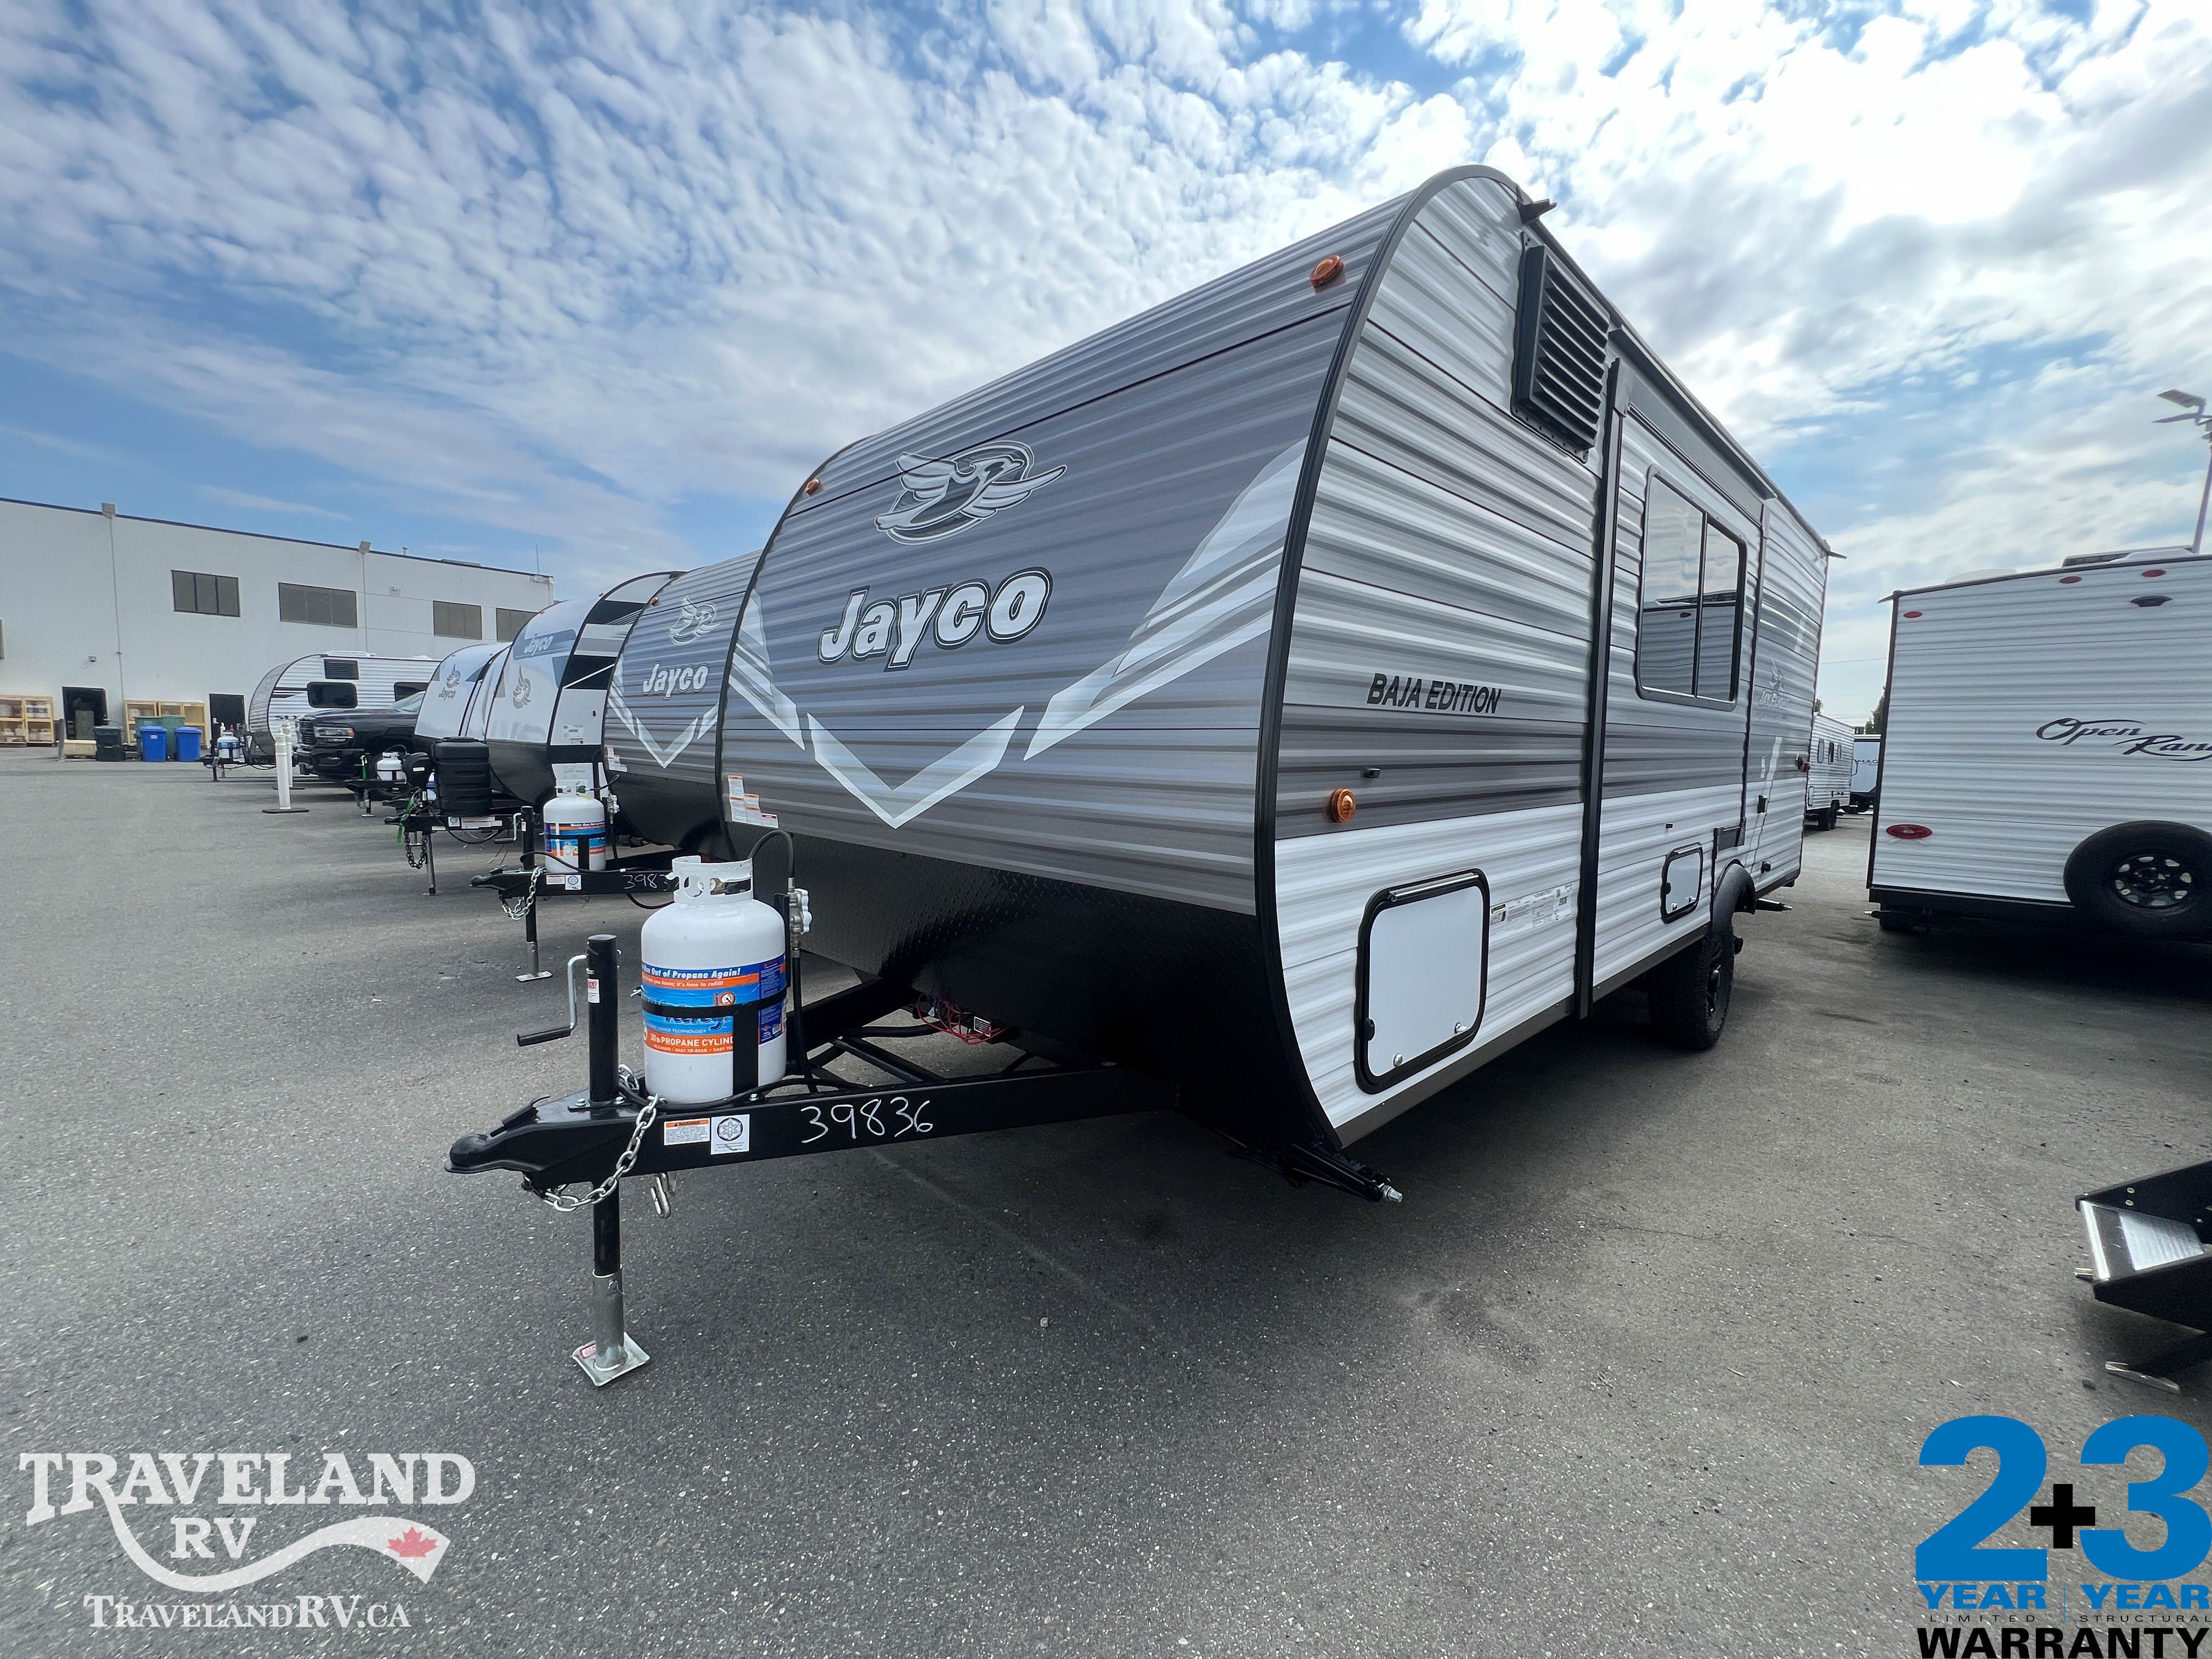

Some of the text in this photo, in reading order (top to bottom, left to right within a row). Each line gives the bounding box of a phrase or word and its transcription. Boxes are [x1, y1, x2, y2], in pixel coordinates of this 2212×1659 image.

[818, 567, 1053, 672] Jayco
[524, 633, 554, 656] Jayco
[642, 662, 709, 700] Jayco
[1367, 673, 1502, 714] BAJA EDITION
[439, 687, 456, 701] Jayco
[2036, 718, 2146, 746] Open
[623, 874, 679, 891] 3983
[651, 968, 662, 976] Out
[672, 970, 709, 980] Propane
[711, 968, 741, 979] Again!
[661, 1036, 699, 1047] PROPANE
[800, 1097, 933, 1144] 39836
